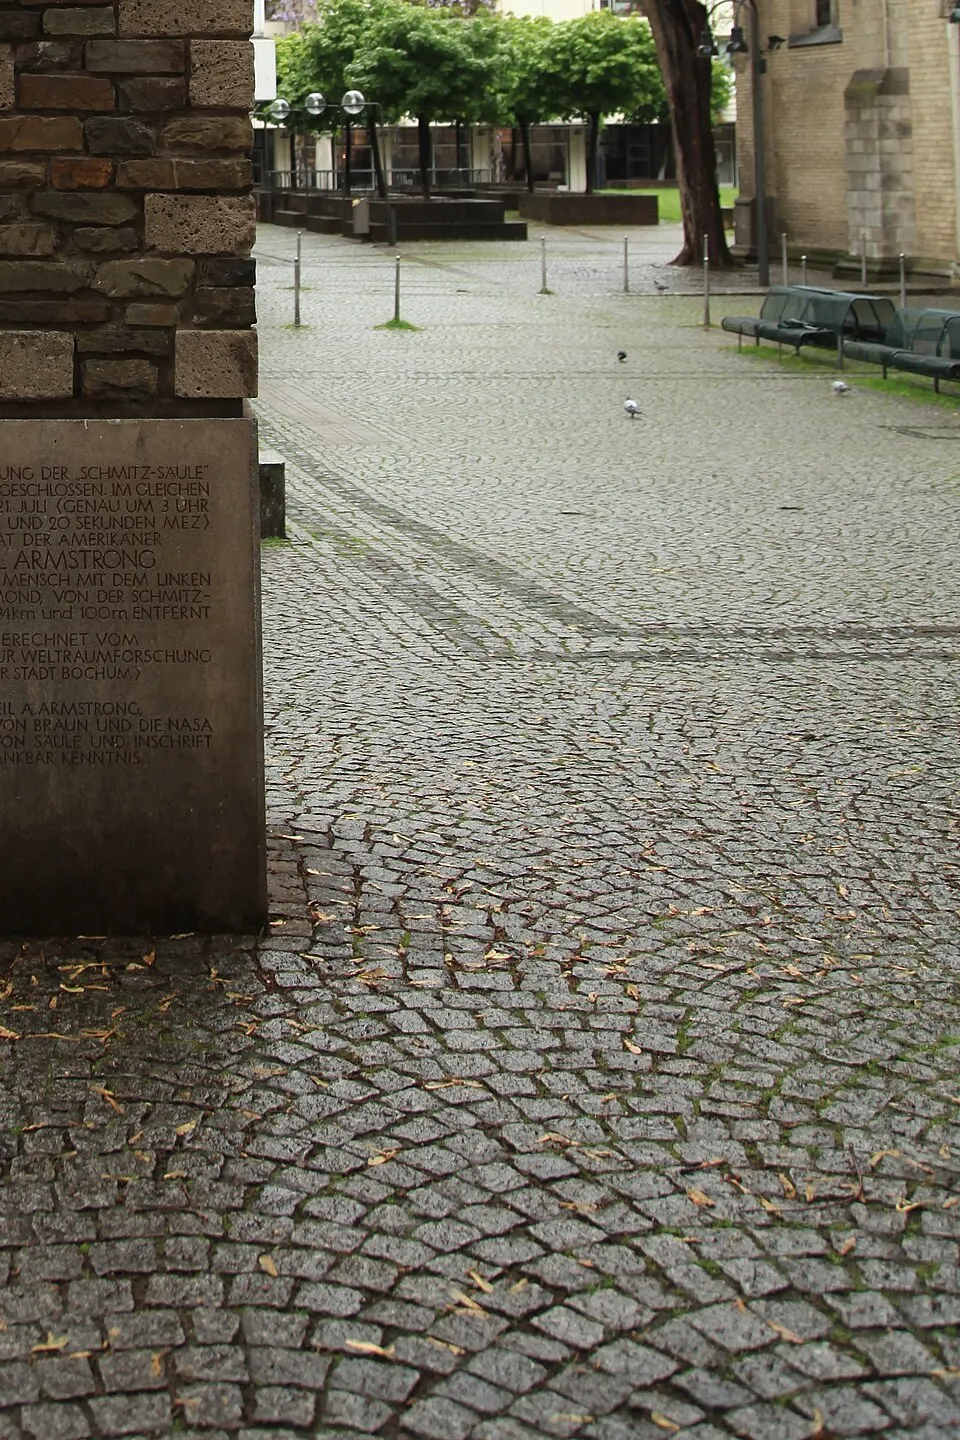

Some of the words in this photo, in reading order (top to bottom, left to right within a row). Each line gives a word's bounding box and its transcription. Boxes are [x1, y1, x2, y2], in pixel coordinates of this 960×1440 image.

[42, 466, 68, 481] DER
[112, 483, 132, 497] IM
[135, 483, 209, 497] GLEICHEN
[17, 499, 48, 514] JULI
[125, 499, 153, 514] UM
[161, 499, 169, 514] 3
[176, 499, 208, 514] UHR
[7, 517, 42, 530] UND
[48, 517, 70, 530] 20
[76, 517, 155, 530] SEKUNDEN
[23, 532, 51, 546] DER
[58, 532, 161, 546] AMERIKANER
[13, 549, 156, 570] ARMSTRONG
[3, 573, 70, 587] MENSCH
[77, 573, 104, 587] MIT
[112, 573, 148, 587] DEM
[157, 573, 210, 587] LINKEN
[53, 590, 89, 604] VON
[97, 590, 124, 604] DER
[132, 590, 211, 604] SCHMITZ-
[41, 606, 72, 620] und
[81, 606, 127, 620] 100m
[133, 606, 210, 620] ENTFERNT
[95, 633, 138, 647] VOM
[21, 649, 212, 663] WELTRAUMFORSCHUNG
[13, 667, 55, 681] STADT
[34, 718, 88, 733] BRAUN
[96, 718, 131, 733] UND
[139, 718, 162, 733] DIE
[168, 718, 213, 733] NASA
[34, 735, 81, 749] SÄULE
[90, 735, 125, 749] UND
[134, 735, 213, 749] INSCHRIFT
[61, 752, 141, 765] KENNTNIS
